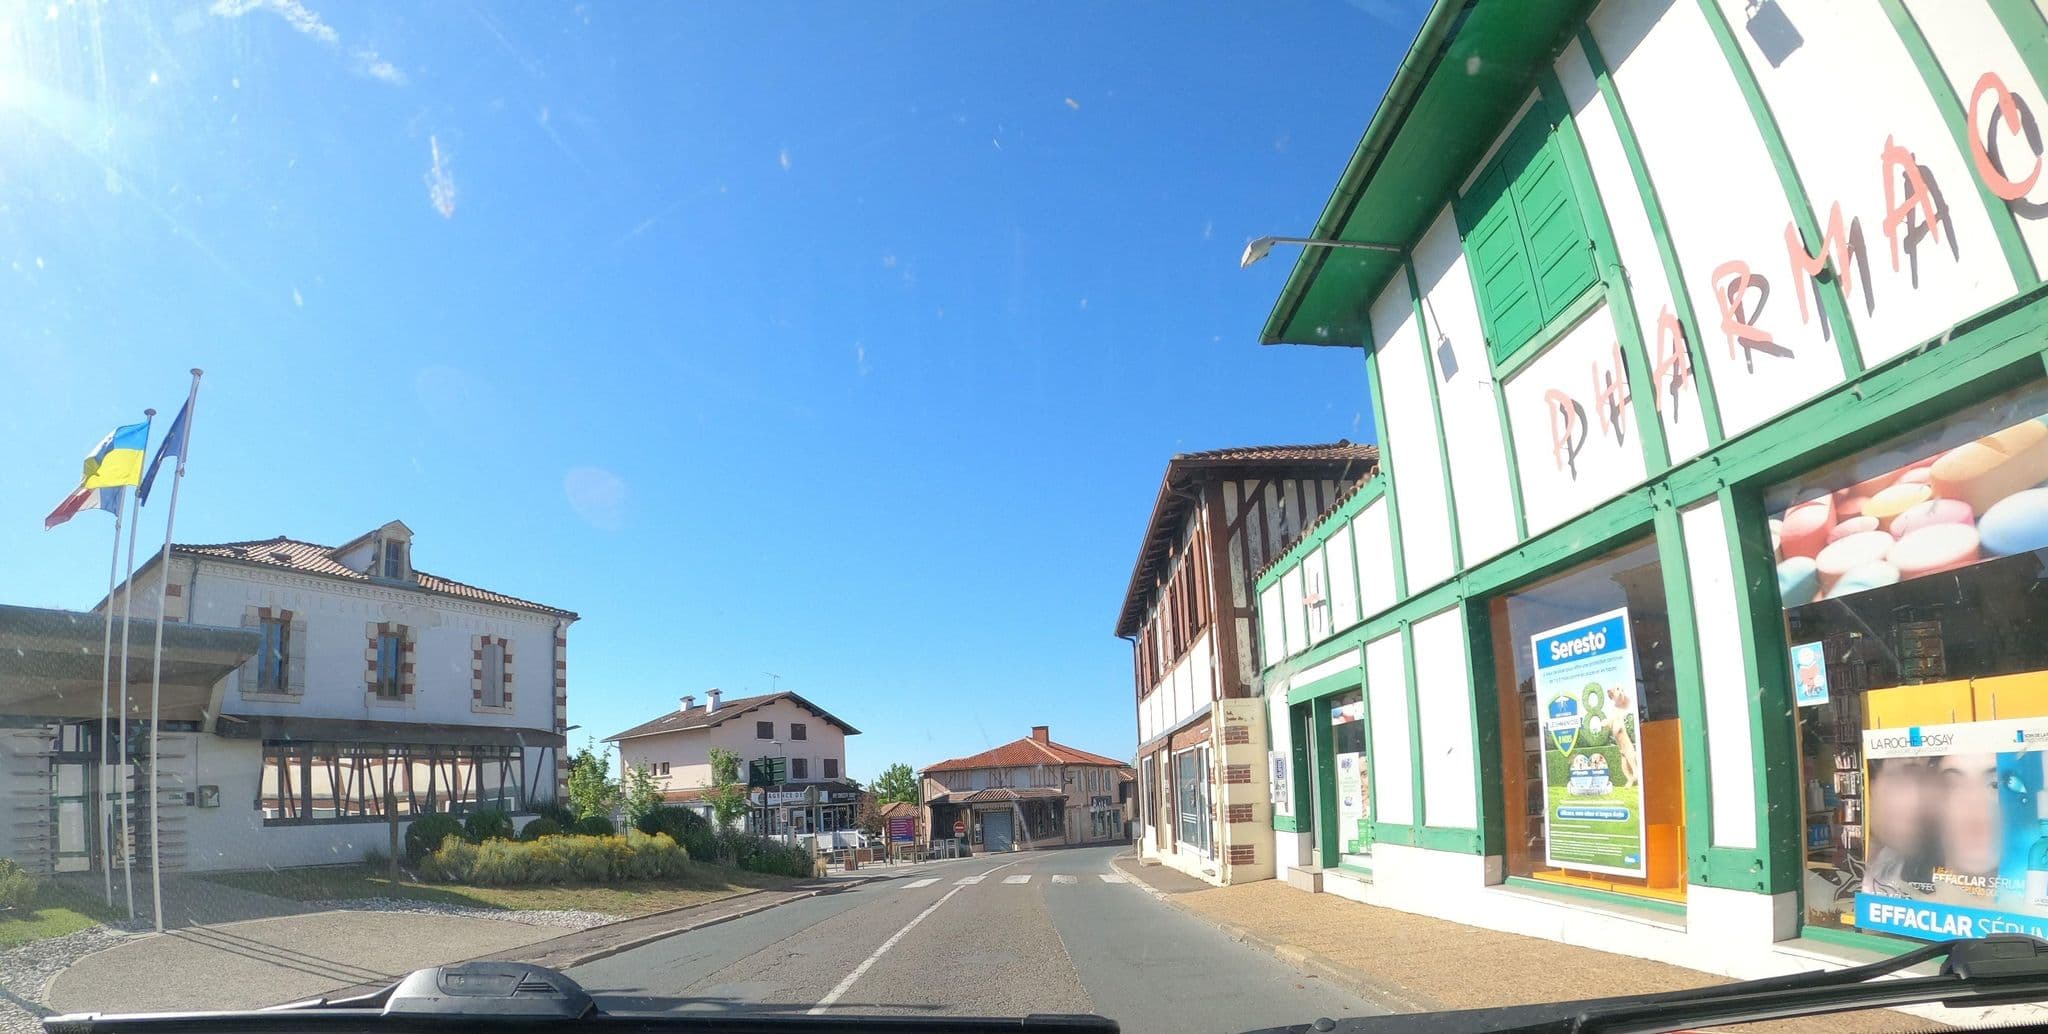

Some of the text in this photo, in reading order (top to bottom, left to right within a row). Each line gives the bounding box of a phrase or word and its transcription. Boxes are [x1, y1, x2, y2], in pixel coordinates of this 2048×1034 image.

[1550, 631, 1606, 661] Seresto
[1921, 733, 1954, 747] POSAY
[1932, 872, 1986, 888] EFFACLAR
[1869, 902, 1973, 937] EFFACLAR
